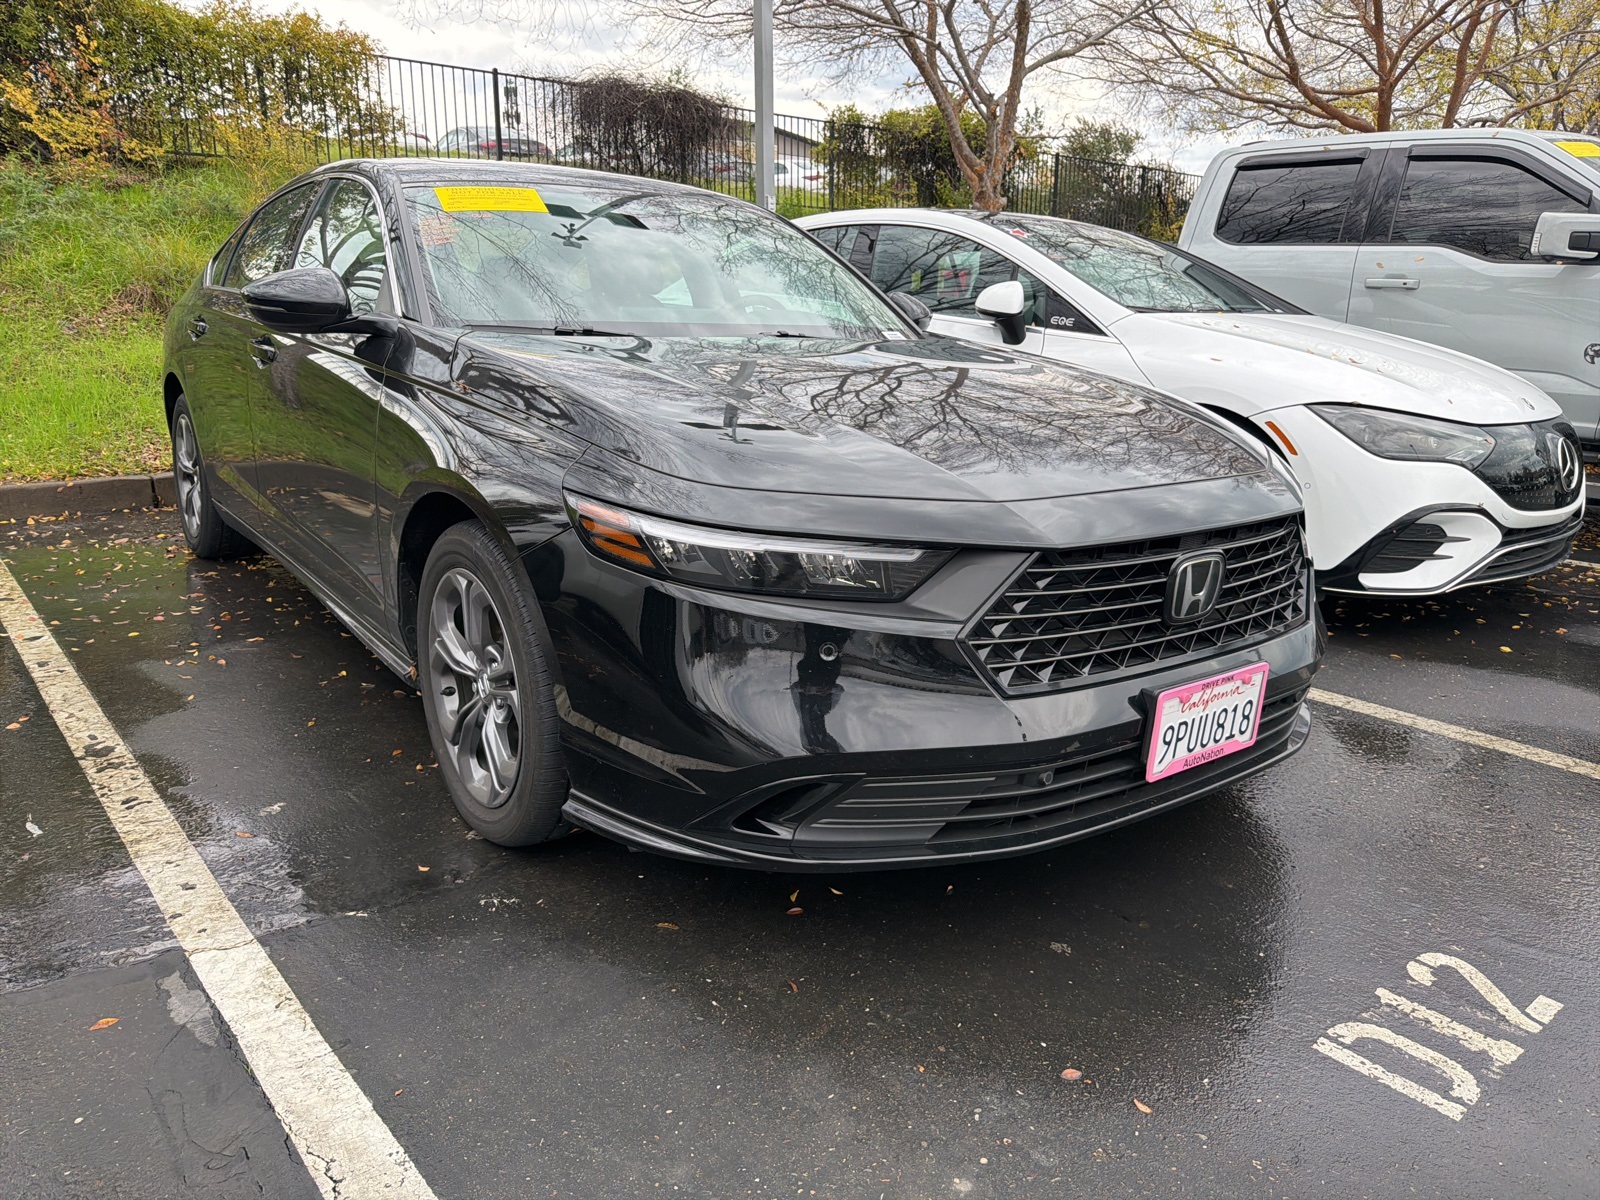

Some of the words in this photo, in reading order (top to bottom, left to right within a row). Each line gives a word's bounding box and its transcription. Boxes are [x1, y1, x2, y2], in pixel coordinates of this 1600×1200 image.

[1050, 316, 1075, 326] EQE
[1201, 680, 1219, 690] DRIVE
[1220, 675, 1235, 685] PINK
[1181, 685, 1244, 713] California
[1158, 699, 1253, 765] 9PUU818
[1182, 747, 1224, 769] AutoNation
[1311, 952, 1565, 1122] D12
